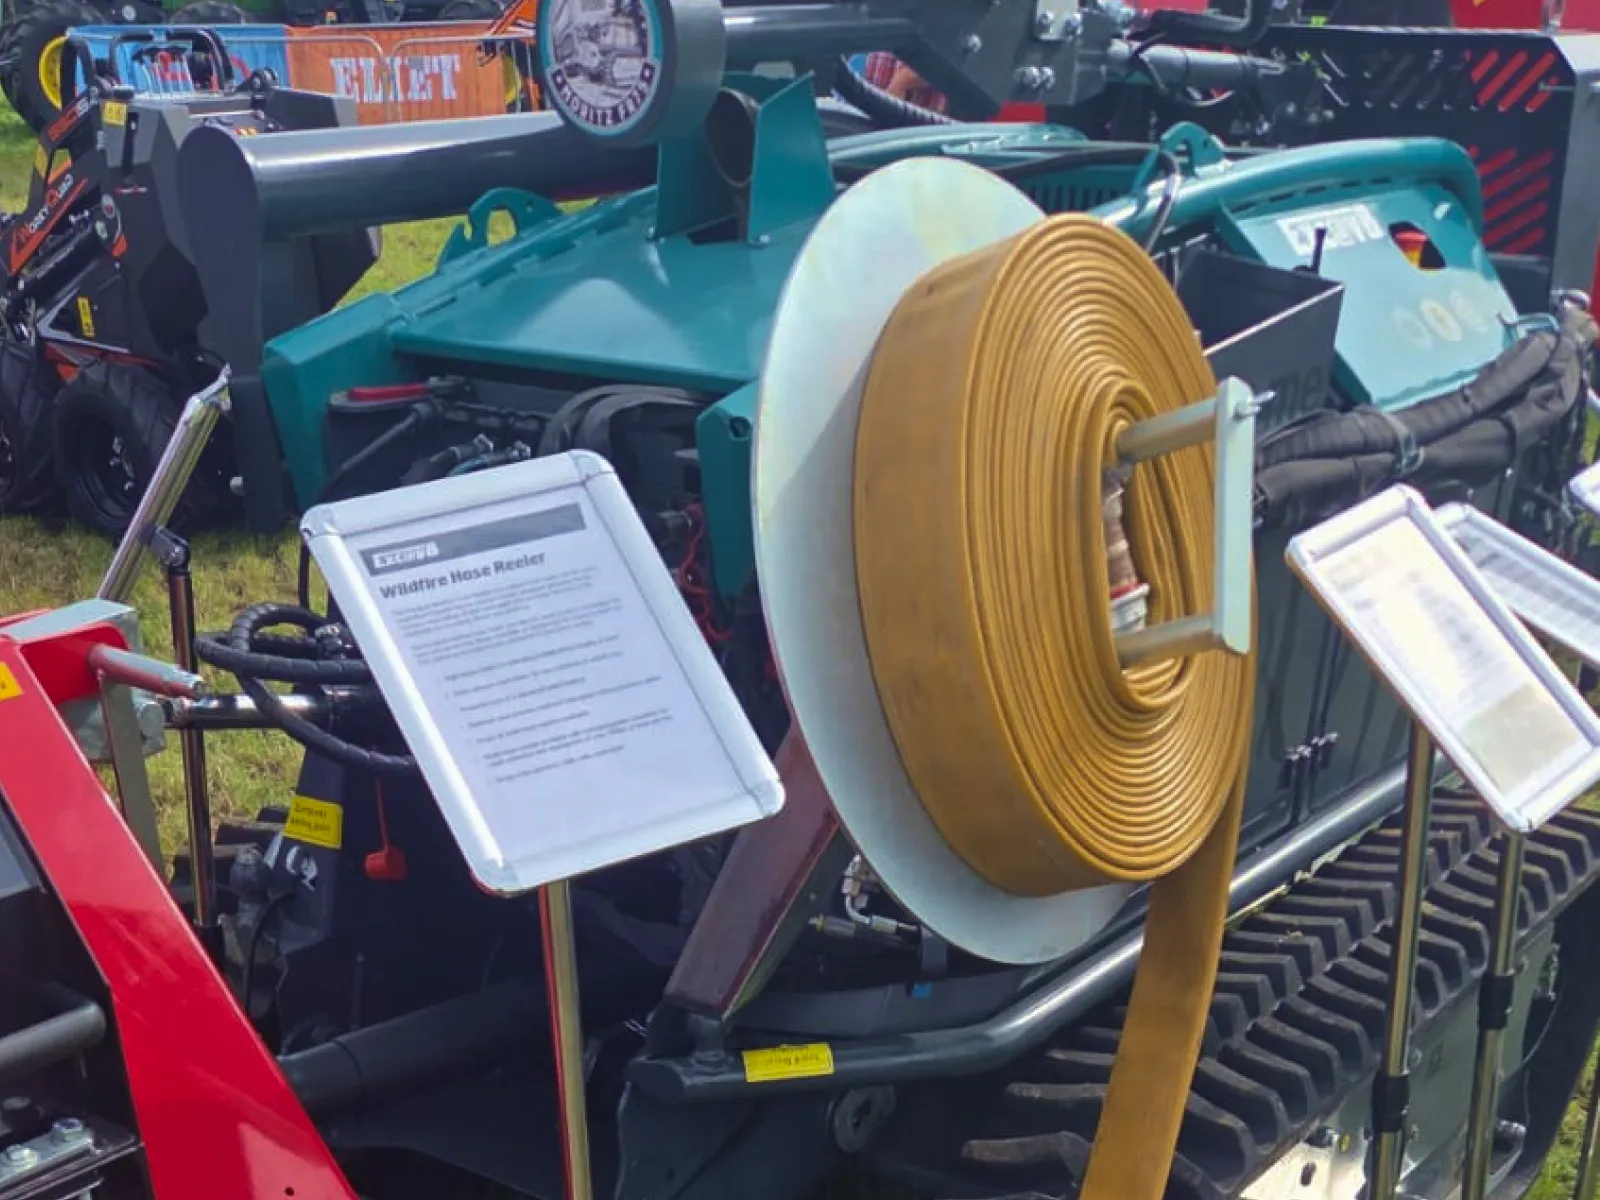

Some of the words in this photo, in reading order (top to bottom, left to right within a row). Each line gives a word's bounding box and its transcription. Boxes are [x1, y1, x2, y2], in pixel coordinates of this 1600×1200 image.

[330, 54, 460, 104] ELIET
[379, 575, 448, 599] Wildfire
[450, 564, 491, 584] Hose
[493, 552, 546, 574] Reeler
